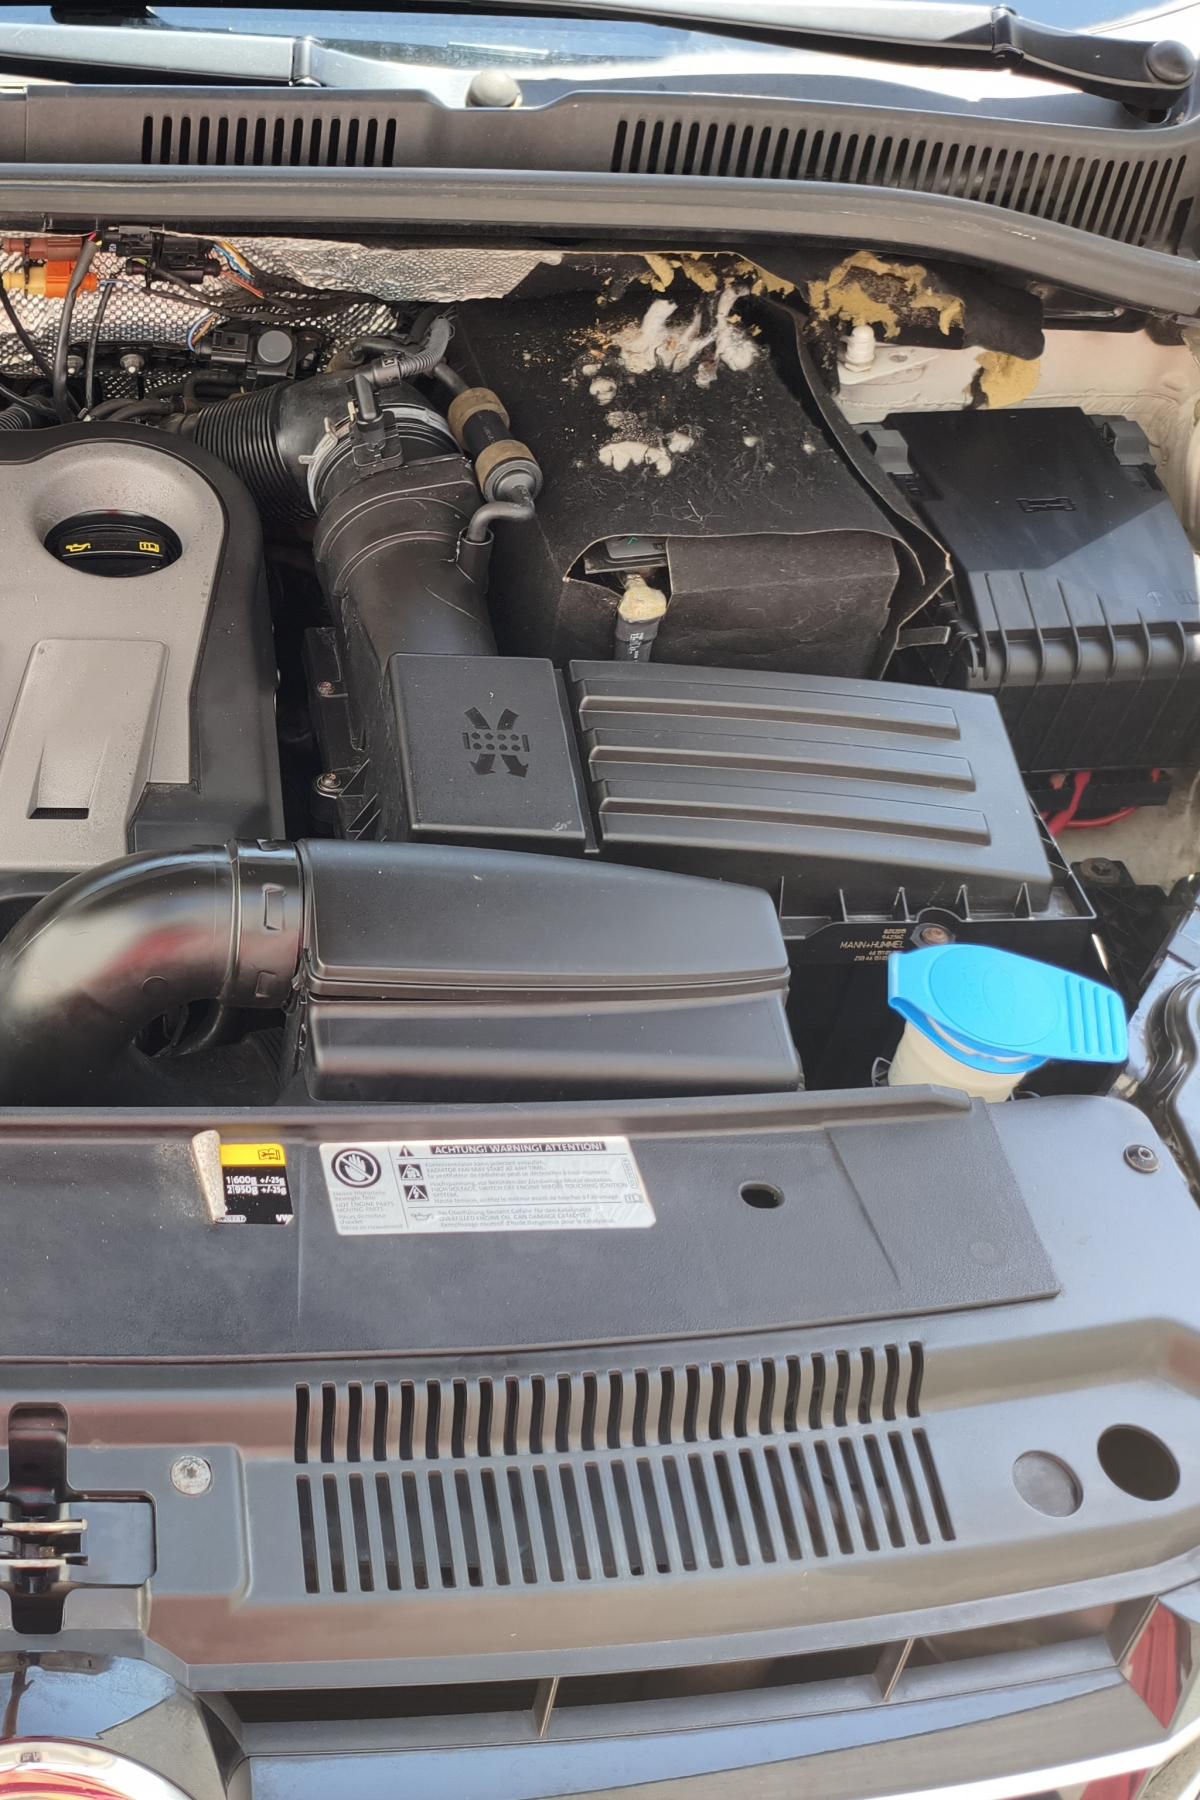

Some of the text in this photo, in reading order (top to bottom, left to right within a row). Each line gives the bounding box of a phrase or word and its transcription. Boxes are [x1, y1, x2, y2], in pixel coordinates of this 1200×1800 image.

[434, 1141, 604, 1154] ACHTUNG! WARNING! ATTENTION!
